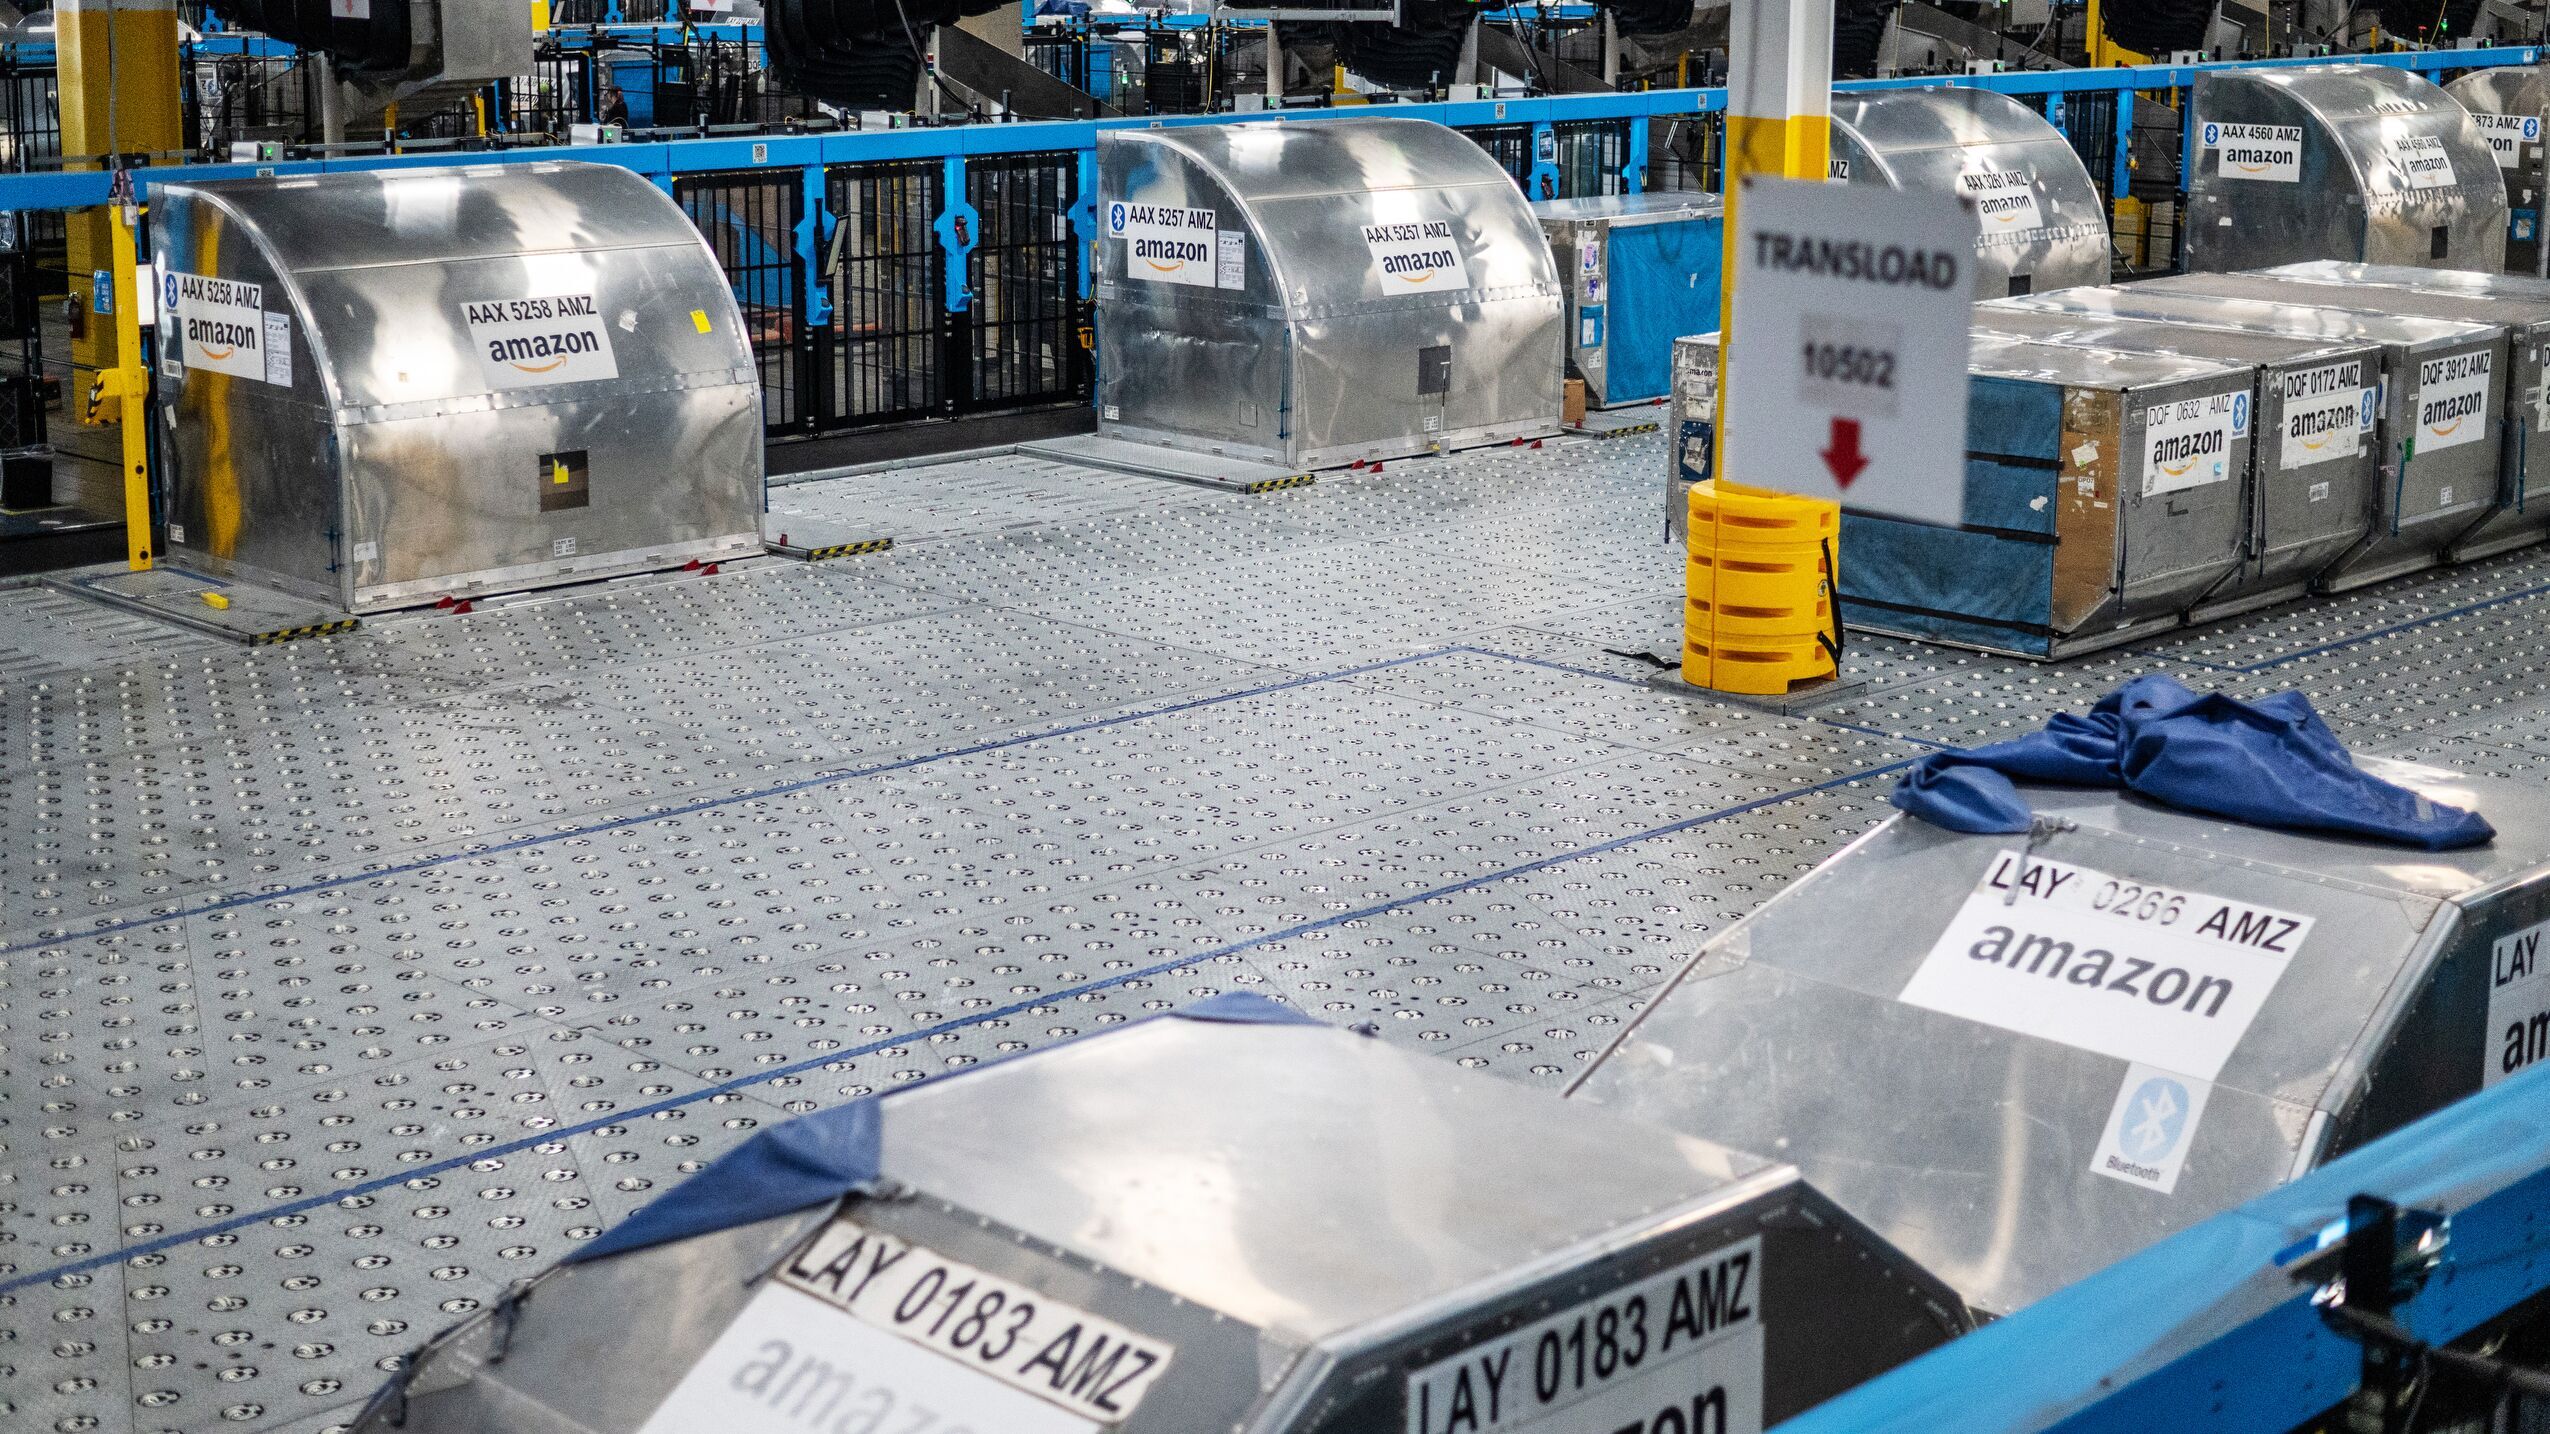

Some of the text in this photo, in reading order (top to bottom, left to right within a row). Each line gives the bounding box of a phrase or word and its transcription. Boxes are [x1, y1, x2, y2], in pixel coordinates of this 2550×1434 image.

[2222, 125, 2300, 142] AAX 4560 AMZ
[2472, 115, 2520, 130] 873 AMZ
[1828, 161, 1847, 178] MZ
[2227, 148, 2293, 164] amazon
[2410, 157, 2448, 173] amazon
[1964, 174, 1986, 191] AAX
[2005, 171, 2028, 187] AMZ
[1130, 205, 1214, 230] AAX 5257 AMZ
[1981, 195, 2032, 214] amazon
[1366, 222, 1451, 243] AAX 5257 AMZ
[1136, 238, 1207, 262] amazon
[1383, 249, 1455, 273] amazon
[1754, 230, 1958, 290] TRANSLOAD
[181, 276, 260, 310] AAX 5258 AMZ
[469, 296, 597, 324] AAX 5258 AMZ
[188, 318, 256, 350] amazon
[488, 330, 600, 362] amazon
[1803, 341, 1896, 390] 10502
[2287, 364, 2359, 398] DQF 0172 AMZ
[2422, 352, 2490, 386] DQF 3912 AMZ
[2149, 394, 2231, 427] DQF 0632 AMZ
[2290, 404, 2354, 438] amazon
[2423, 390, 2482, 426] amazon
[2153, 429, 2223, 464] amazon
[1989, 857, 2301, 953] LAY 0266 AMZ
[1968, 924, 2235, 1019] amazon
[2495, 931, 2541, 987] LAY
[2106, 1155, 2160, 1182] Bluetooth
[786, 1224, 1160, 1414] LAY 0183 AMZ
[1535, 1294, 1649, 1404] 0183
[1661, 1251, 1752, 1352] AMZ
